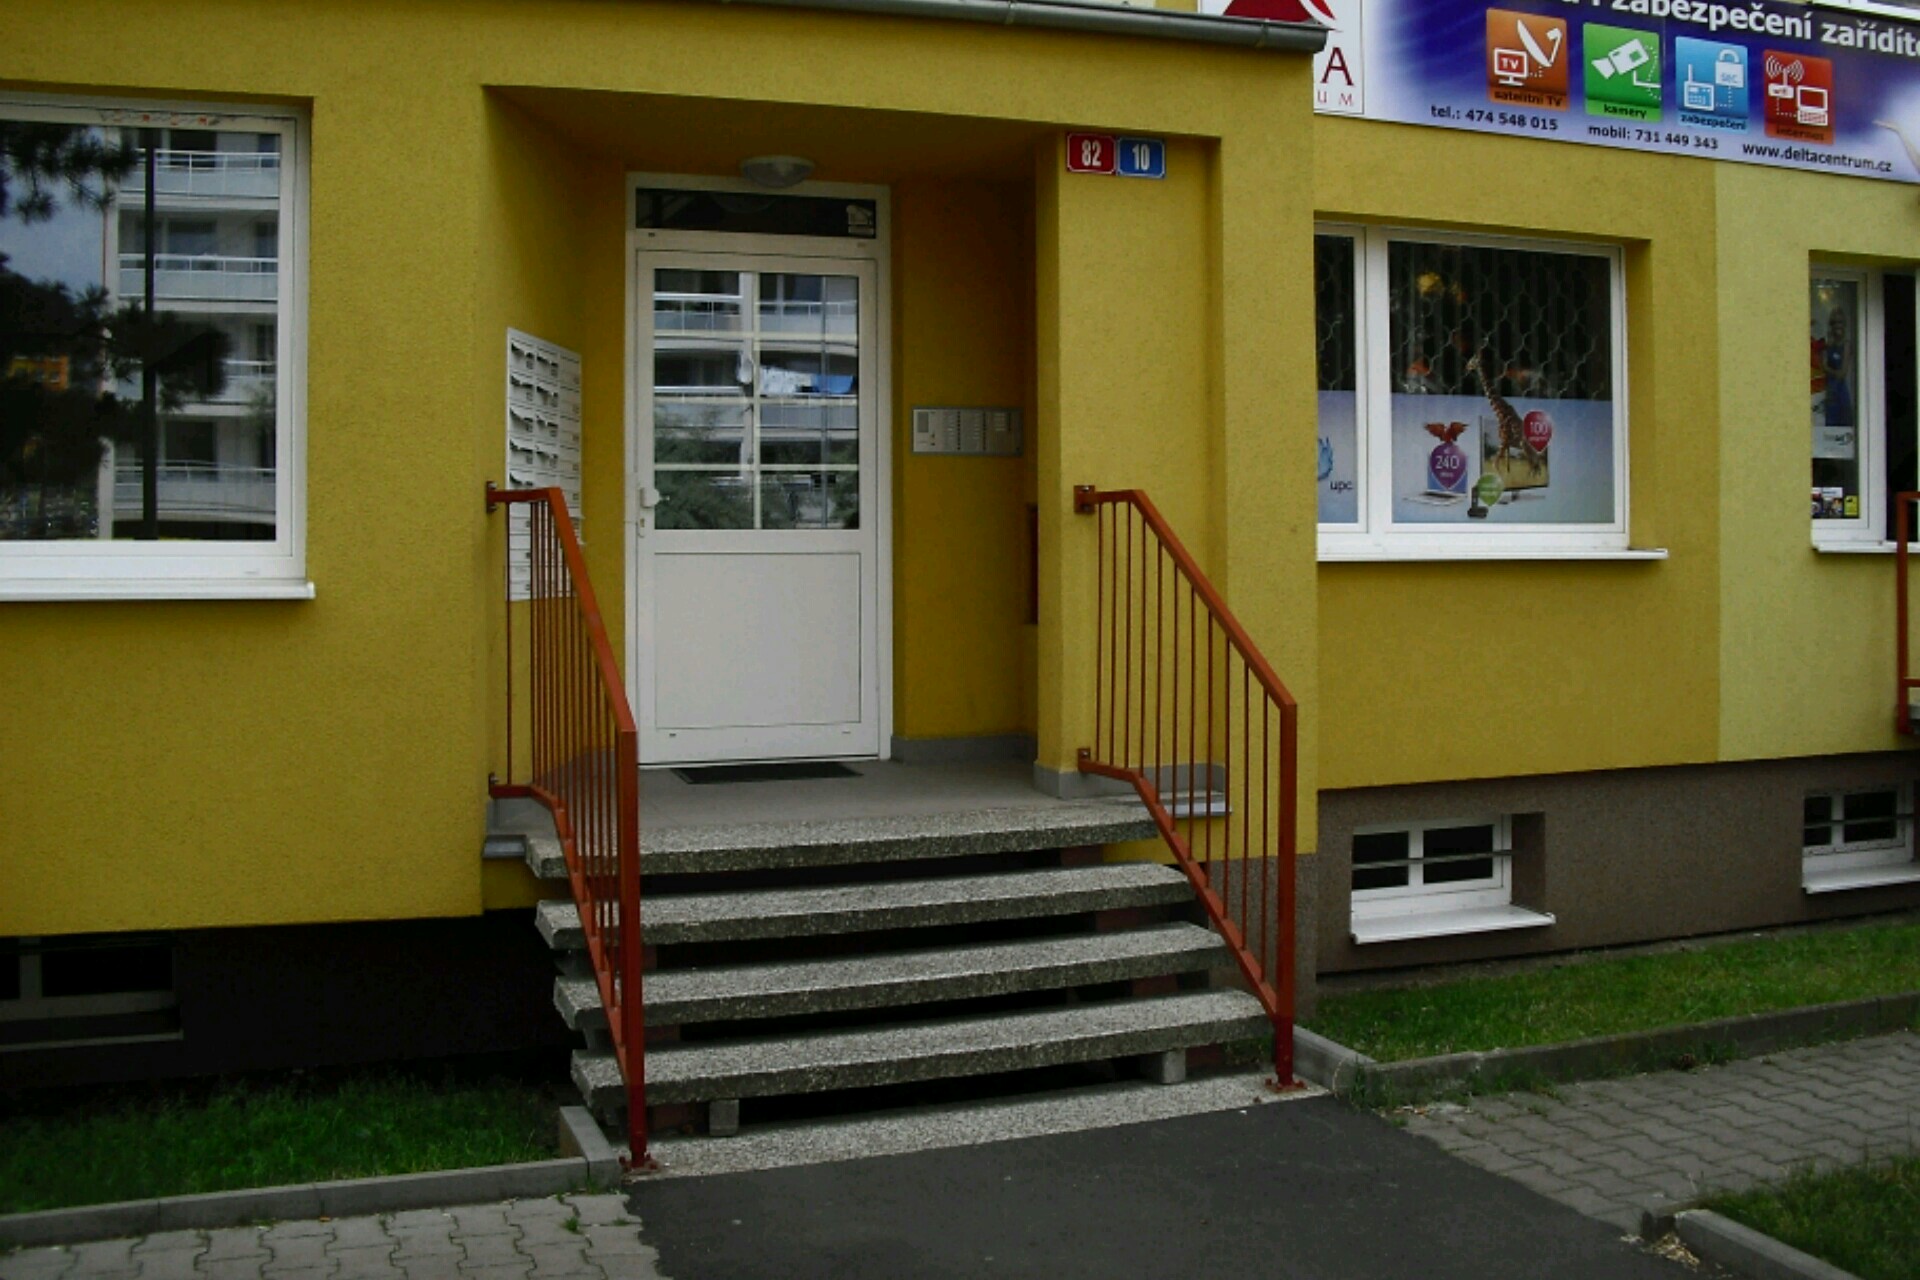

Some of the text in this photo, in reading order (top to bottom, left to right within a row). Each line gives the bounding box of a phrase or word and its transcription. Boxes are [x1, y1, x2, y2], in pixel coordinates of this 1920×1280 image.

[1501, 57, 1519, 70] TV
[1547, 95, 1563, 107] TV
[1431, 105, 1559, 131] tel.: 474 548 015
[1603, 104, 1648, 119] kamery
[1588, 125, 1719, 150] mobil: 731 449 343
[1081, 139, 1102, 167] 82
[1132, 143, 1150, 171] 10
[1743, 143, 1892, 173] www.deltacentrum.cz
[1435, 455, 1460, 469] 240
[1330, 481, 1353, 494] upc
